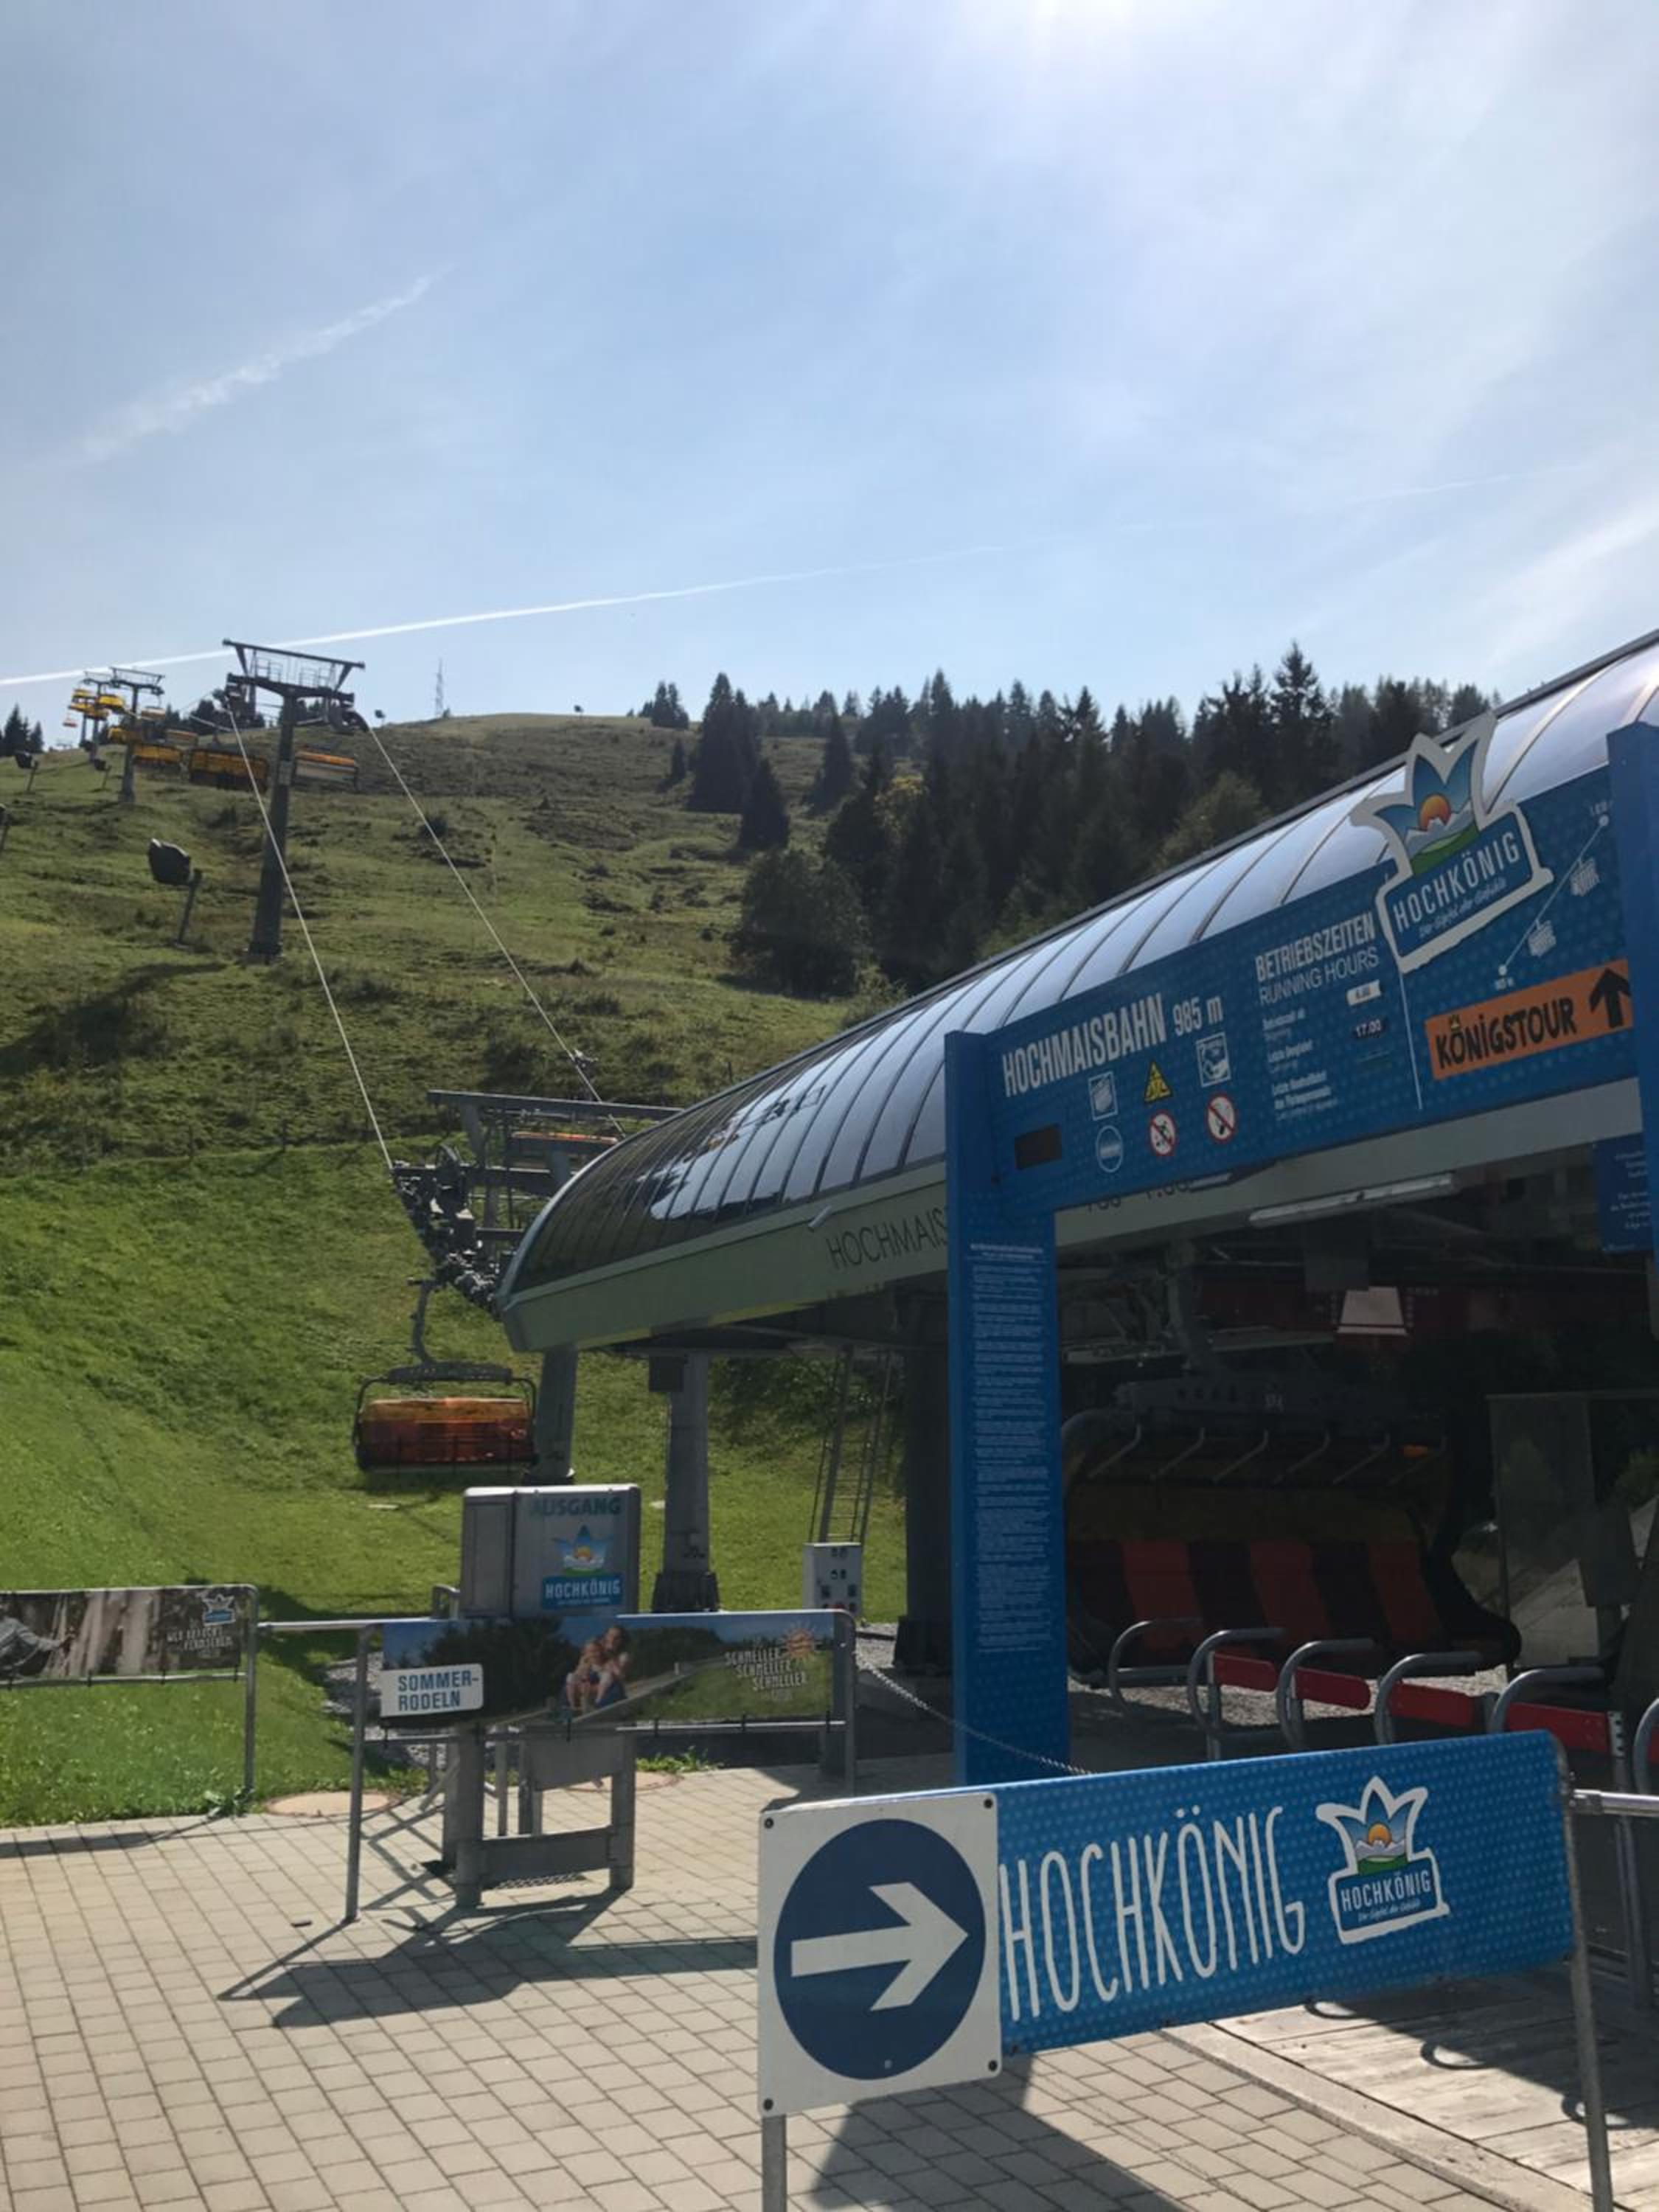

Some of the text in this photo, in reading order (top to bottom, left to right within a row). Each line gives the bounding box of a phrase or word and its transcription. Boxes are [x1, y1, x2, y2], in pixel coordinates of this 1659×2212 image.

[1393, 831, 1520, 933] HOCHKÖNIG
[1255, 911, 1376, 983] BETRIEBSZEITEN
[1259, 967, 1323, 1006] RUNNING
[1324, 946, 1380, 984] HOURS
[1002, 992, 1167, 1098] HOCHMAISBAHN
[1172, 997, 1203, 1037] 985
[1206, 996, 1224, 1025] m
[1436, 997, 1577, 1070] KÖNIGSTOUR
[531, 1497, 622, 1515] AUSGANG
[545, 1577, 621, 1599] HOCHKÖNIG
[398, 1669, 479, 1692] SOMMER-
[398, 1690, 461, 1711] RODELN
[999, 1804, 1305, 2022] HOCHKÖNIG
[1340, 1869, 1432, 1912] HOCHKÖNIG
